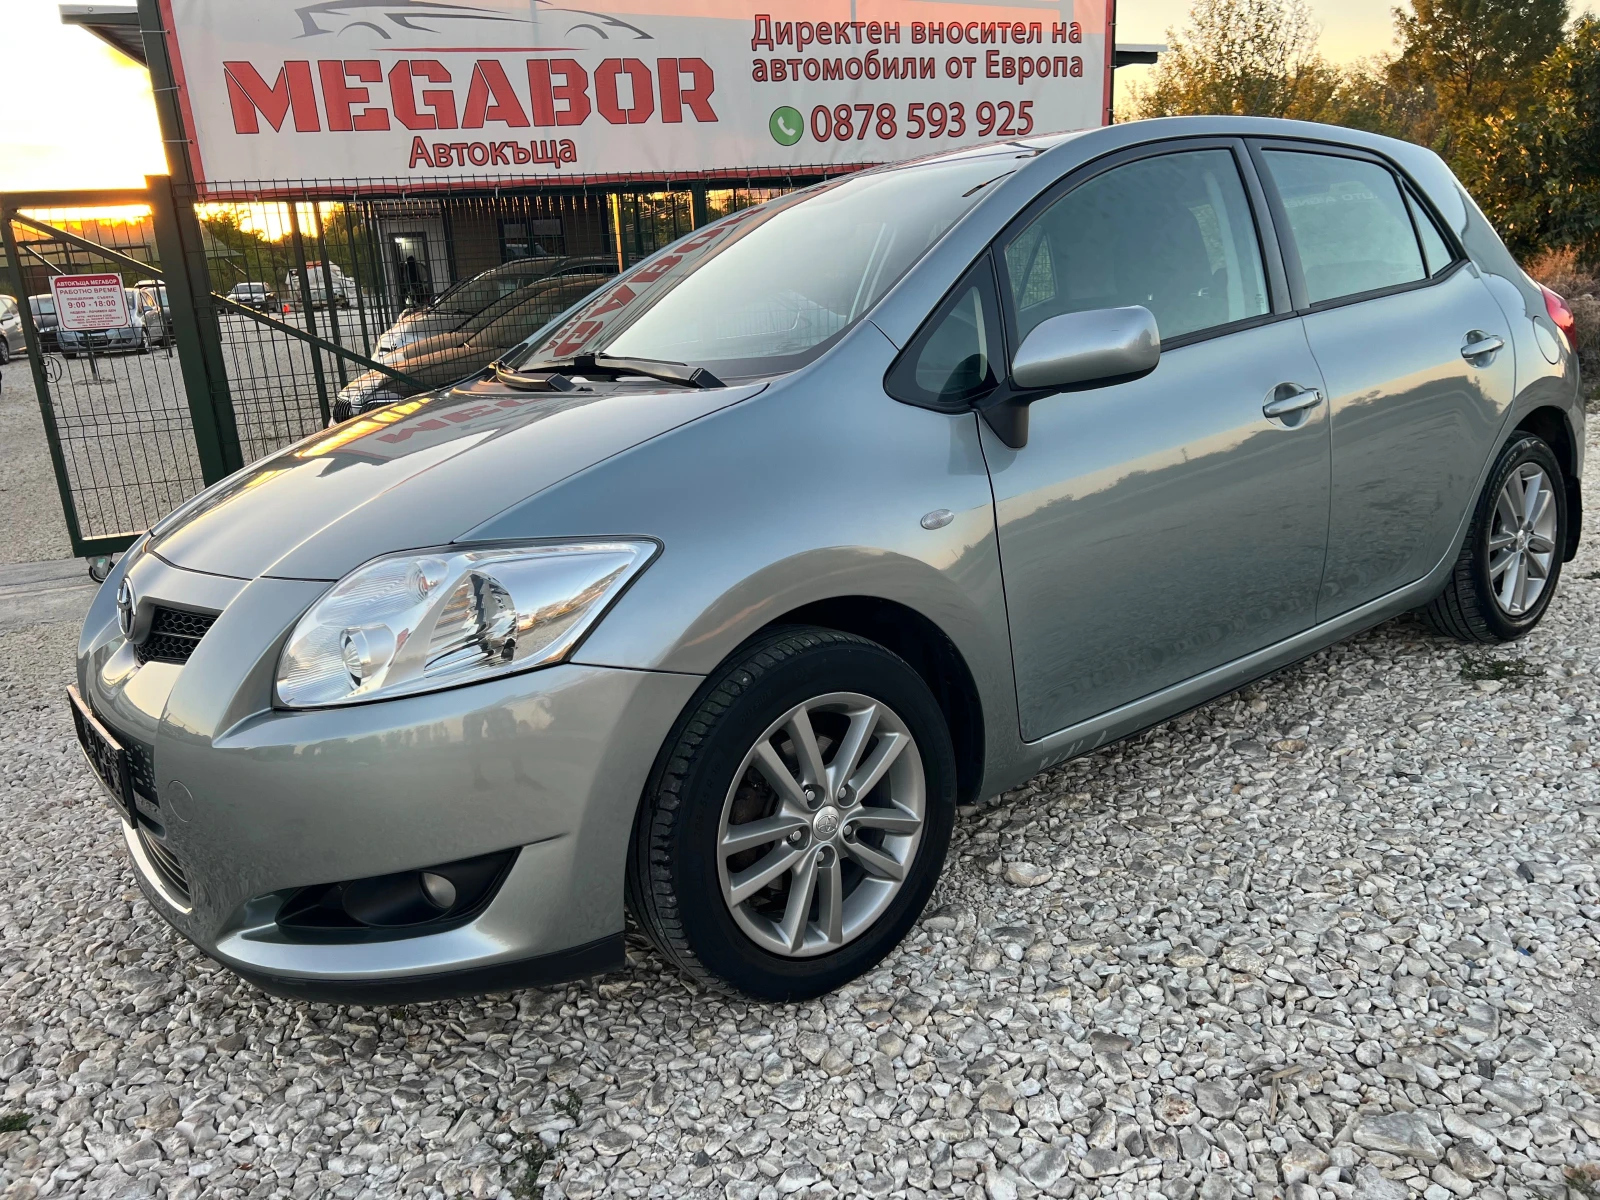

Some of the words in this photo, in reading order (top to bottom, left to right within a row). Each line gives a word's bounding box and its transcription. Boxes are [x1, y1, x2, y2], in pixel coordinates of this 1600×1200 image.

[750, 14, 901, 52] Директен
[910, 21, 1042, 45] вносител
[1051, 20, 1083, 44] на
[751, 49, 936, 82] автомобили
[945, 55, 977, 79] от
[985, 49, 1083, 85] Европа
[222, 57, 719, 134] MEGABOR
[810, 102, 898, 143] 0878
[906, 100, 966, 139] 593
[976, 100, 1034, 137] 925
[408, 135, 578, 169] Автокъща
